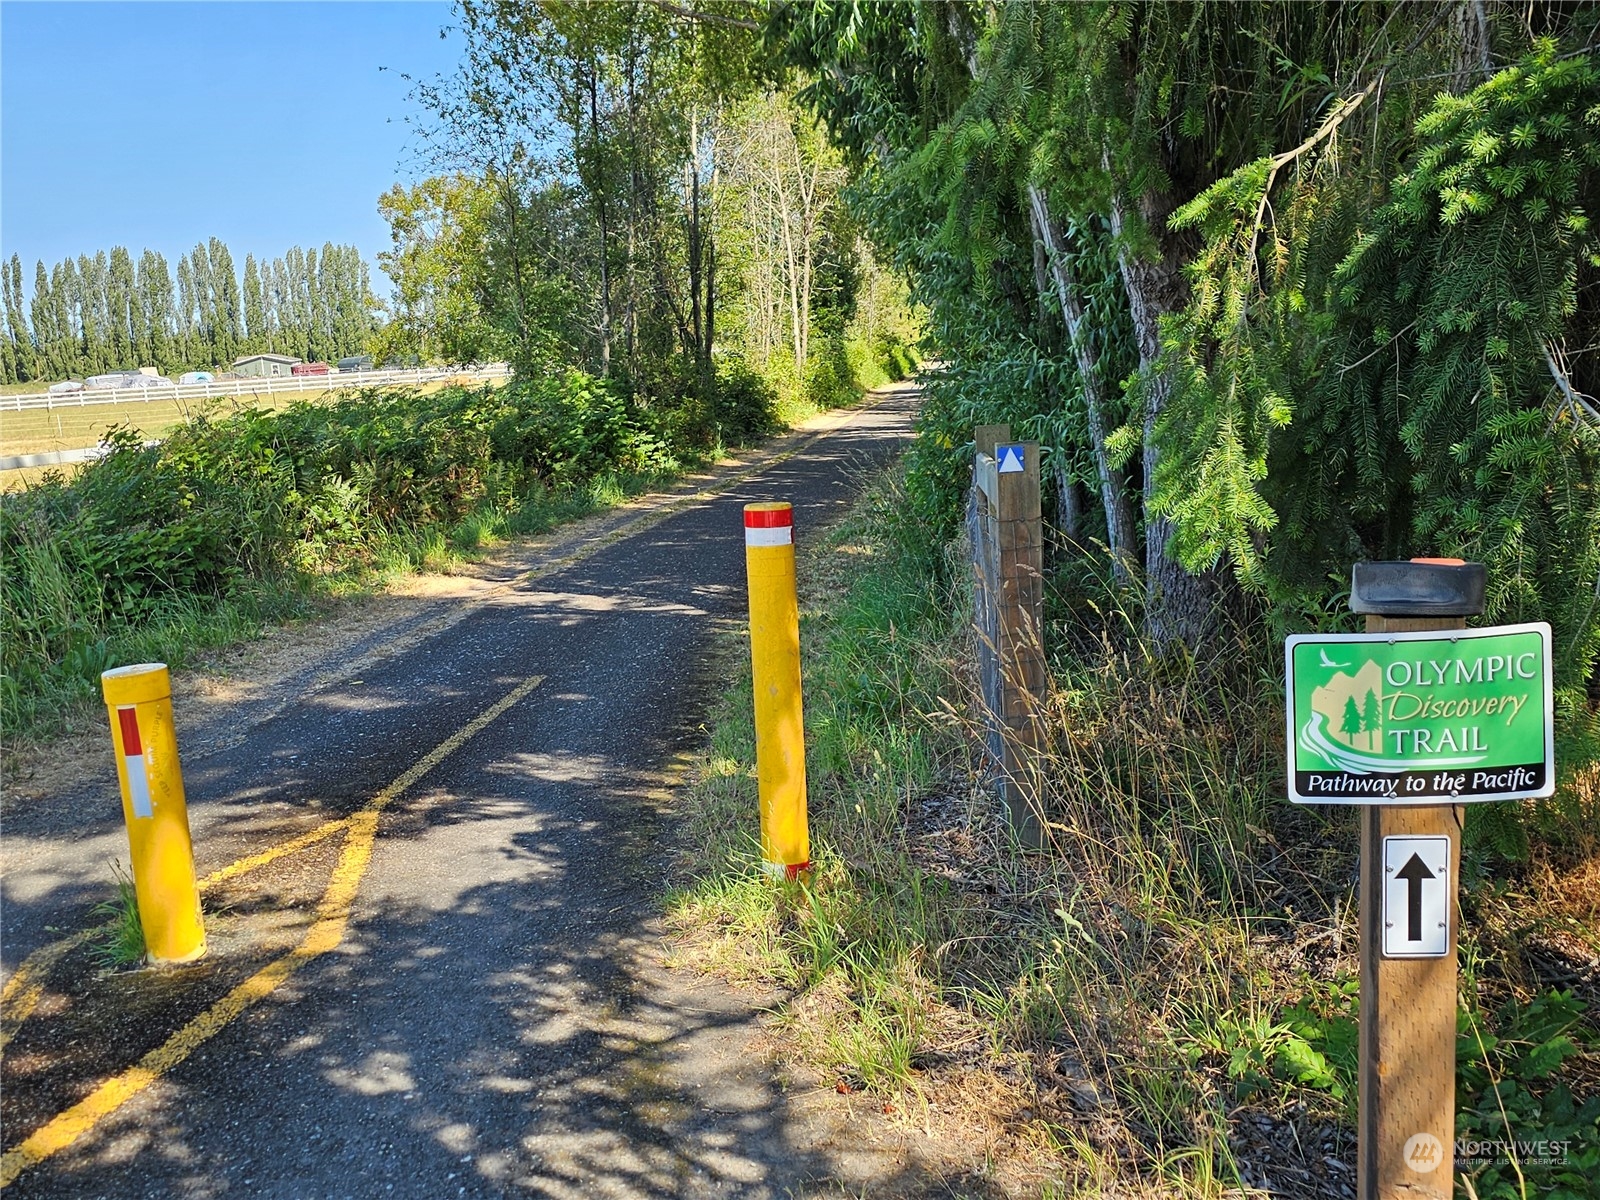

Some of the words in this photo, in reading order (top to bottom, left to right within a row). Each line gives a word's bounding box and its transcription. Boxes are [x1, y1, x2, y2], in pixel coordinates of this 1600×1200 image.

[1386, 652, 1536, 686] OLYMPIC
[1381, 690, 1528, 726] Discovery
[150, 711, 163, 744] PURPLE
[1388, 726, 1488, 754] TRAIL
[1307, 775, 1399, 797] Pathway
[1406, 775, 1426, 791] to
[1433, 772, 1465, 791] the
[1472, 767, 1536, 791] Pacific
